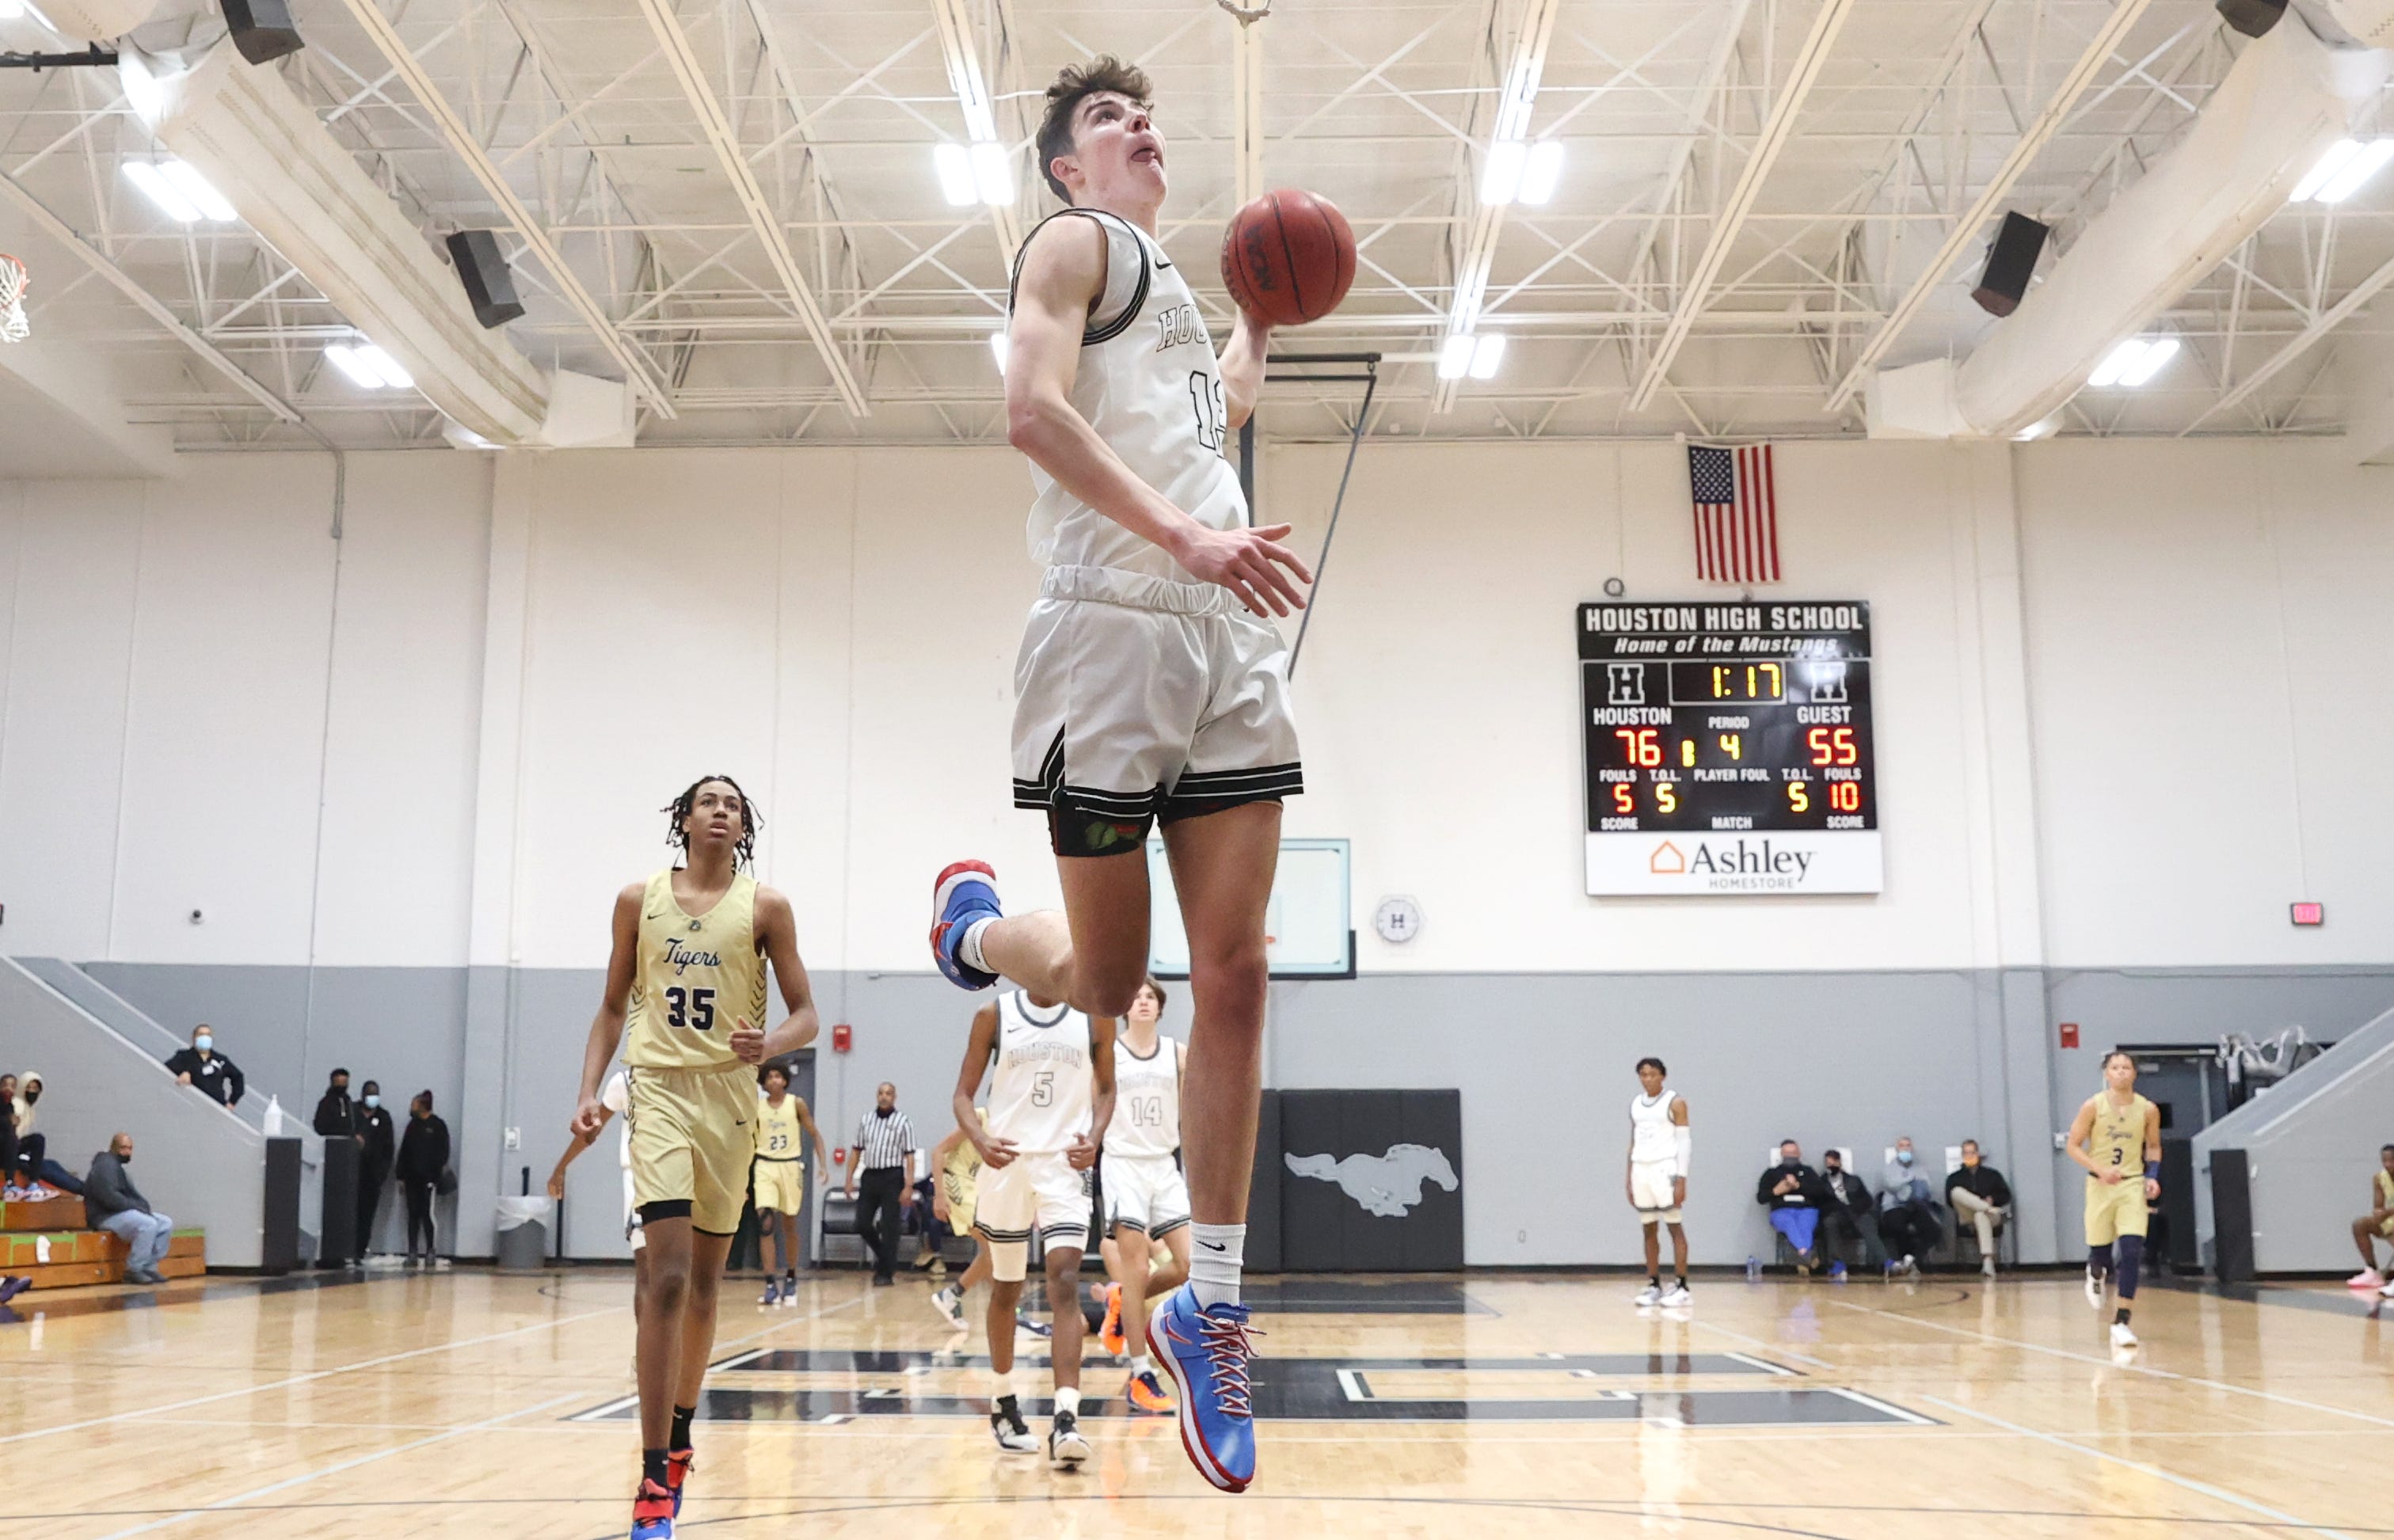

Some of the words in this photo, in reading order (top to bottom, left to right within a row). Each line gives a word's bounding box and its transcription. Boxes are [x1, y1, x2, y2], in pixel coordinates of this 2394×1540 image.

[1585, 607, 1697, 632] HOUSTON
[1704, 606, 1760, 631] HIGH
[1771, 606, 1863, 630] SCHOOL
[1614, 637, 1669, 653] Home
[1674, 635, 1697, 653] of
[1703, 636, 1734, 653] the
[1738, 636, 1838, 656] Mustangs
[1713, 664, 1780, 698] 1:17
[1593, 707, 1672, 725] HOUSTON
[1708, 716, 1749, 729] PERIOD
[1797, 706, 1852, 724] GUEST
[1616, 730, 1661, 766] 76
[1720, 735, 1740, 760] 4
[1810, 728, 1856, 765] 55
[1600, 769, 1637, 782] FOULS
[1649, 769, 1682, 782] T.O.L.
[1694, 768, 1737, 781] PLAYER
[1741, 768, 1771, 781] FOUL
[1782, 767, 1814, 781] T.O.L.
[1825, 767, 1861, 781] FOULS
[1614, 783, 1633, 812] 5
[1656, 783, 1676, 813] 5
[1788, 781, 1808, 812] 5
[1831, 781, 1859, 811] 10
[1600, 817, 1639, 830] SCORE
[1711, 816, 1753, 829] MATCH
[1826, 816, 1865, 828] SCORE
[1689, 839, 1813, 882] Ashley
[1709, 877, 1794, 888] HOMESTORE
[664, 937, 721, 975] Tigers
[664, 987, 716, 1031] 35
[1007, 1040, 1083, 1070] HOUSTON
[1032, 1071, 1054, 1107] 5
[1131, 1096, 1162, 1127] 14
[770, 1134, 787, 1150] 23
[2111, 1147, 2123, 1165] 3
